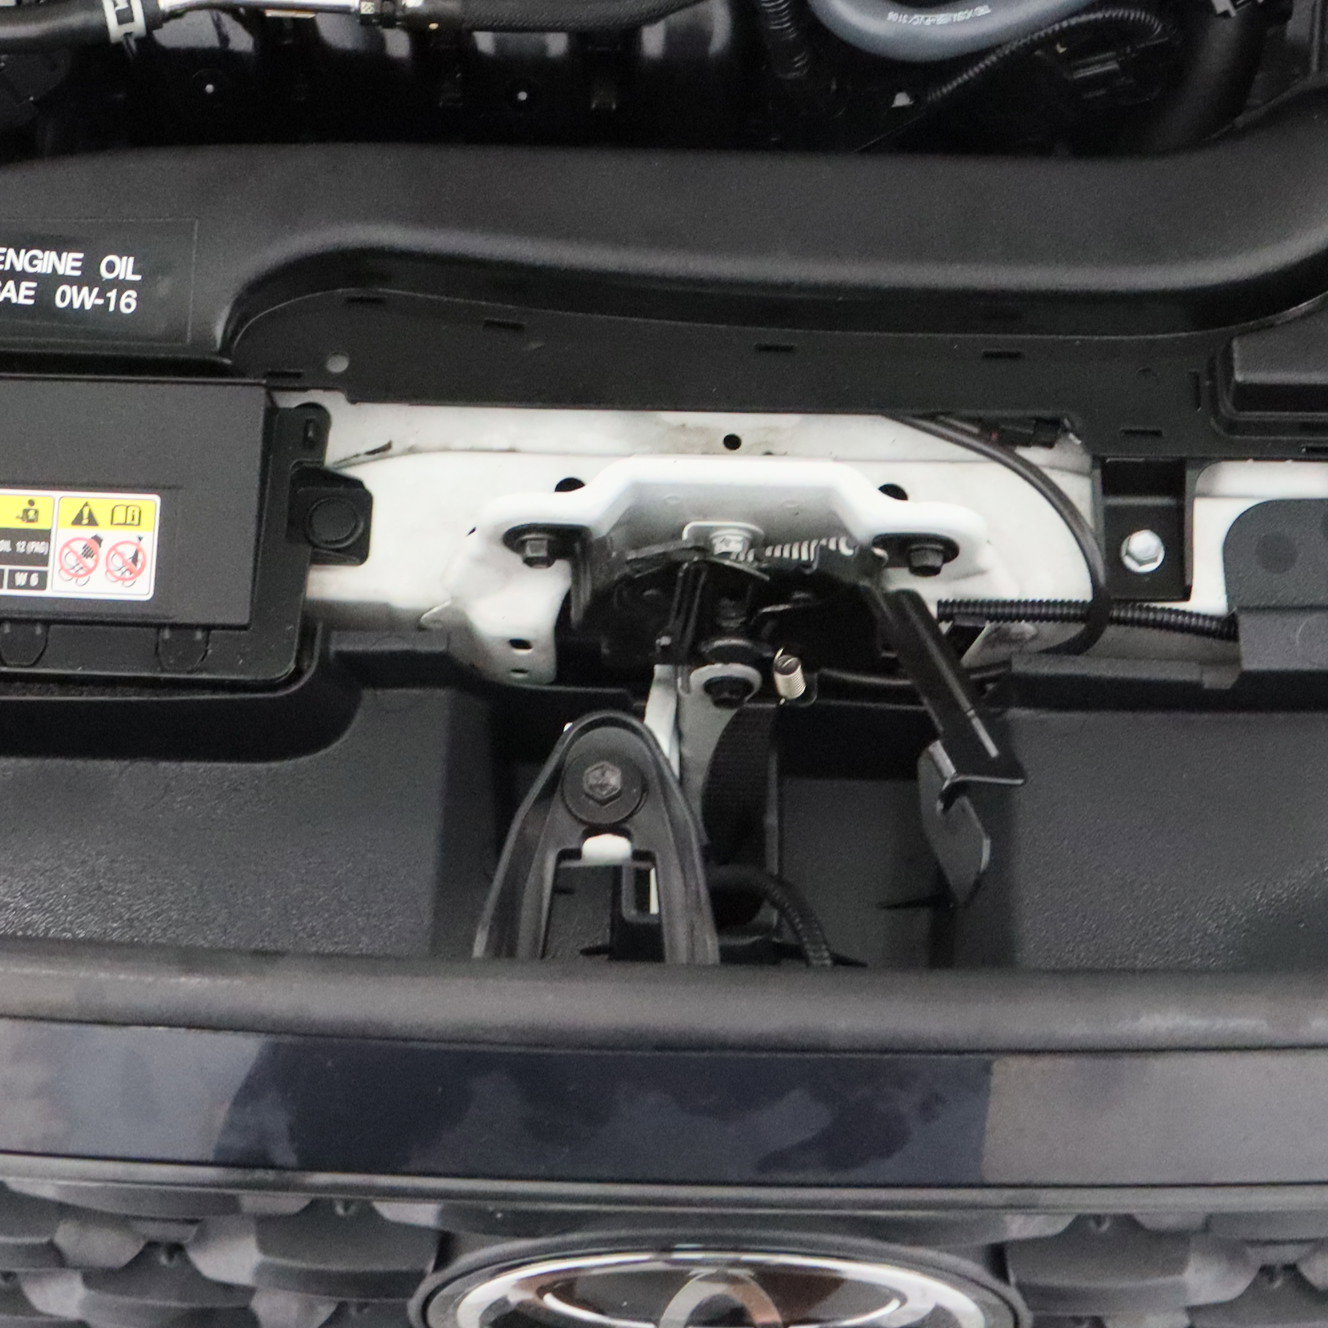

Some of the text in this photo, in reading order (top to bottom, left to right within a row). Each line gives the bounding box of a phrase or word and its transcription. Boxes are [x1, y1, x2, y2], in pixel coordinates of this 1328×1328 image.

[100, 255, 142, 281] OIL
[55, 284, 137, 314] 0W-16
[14, 571, 39, 587] W 6
